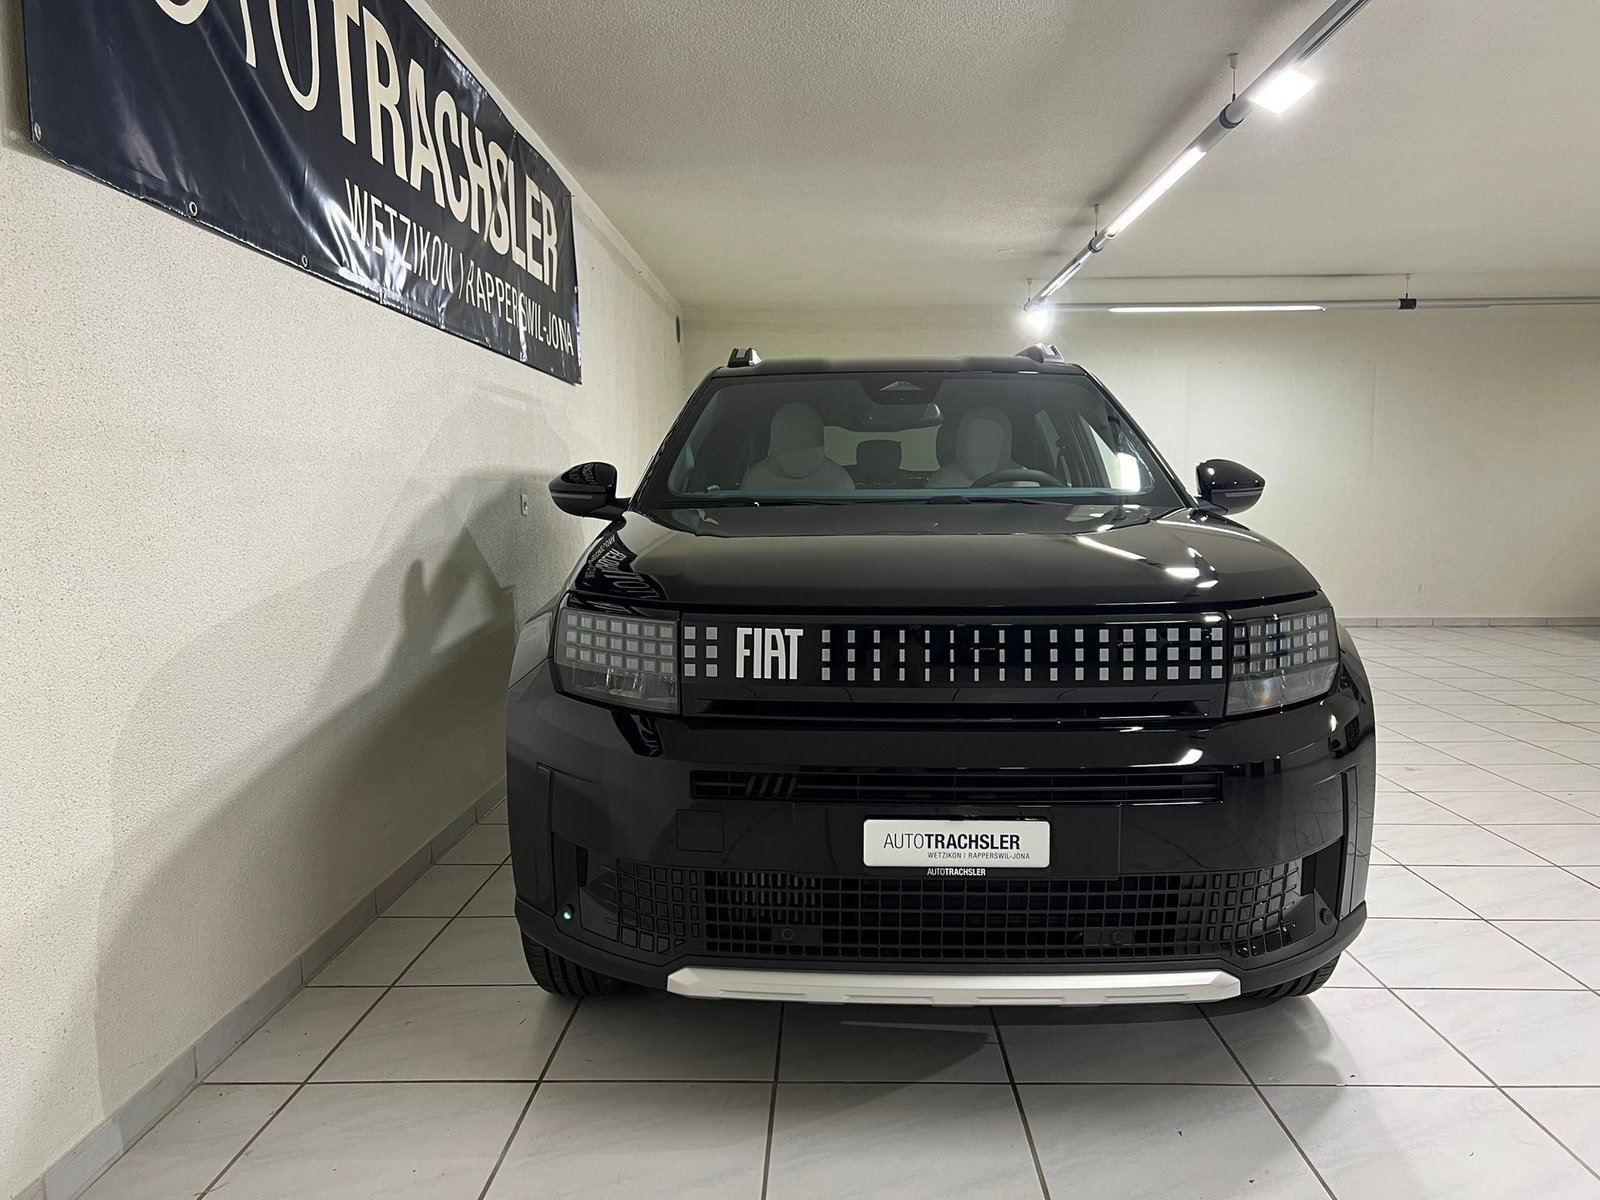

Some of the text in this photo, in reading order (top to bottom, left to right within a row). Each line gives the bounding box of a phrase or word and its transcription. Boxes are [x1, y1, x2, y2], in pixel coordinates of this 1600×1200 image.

[345, 177, 454, 294] WETZIKON
[465, 259, 575, 357] RAPPERSWIL-JONA
[735, 627, 804, 680] FIAT
[883, 833, 1021, 850] AUTOTRACHSLER
[968, 852, 1030, 860] RAPPERSWIL-JONA
[927, 867, 986, 876] AUTOTRACHSLER
